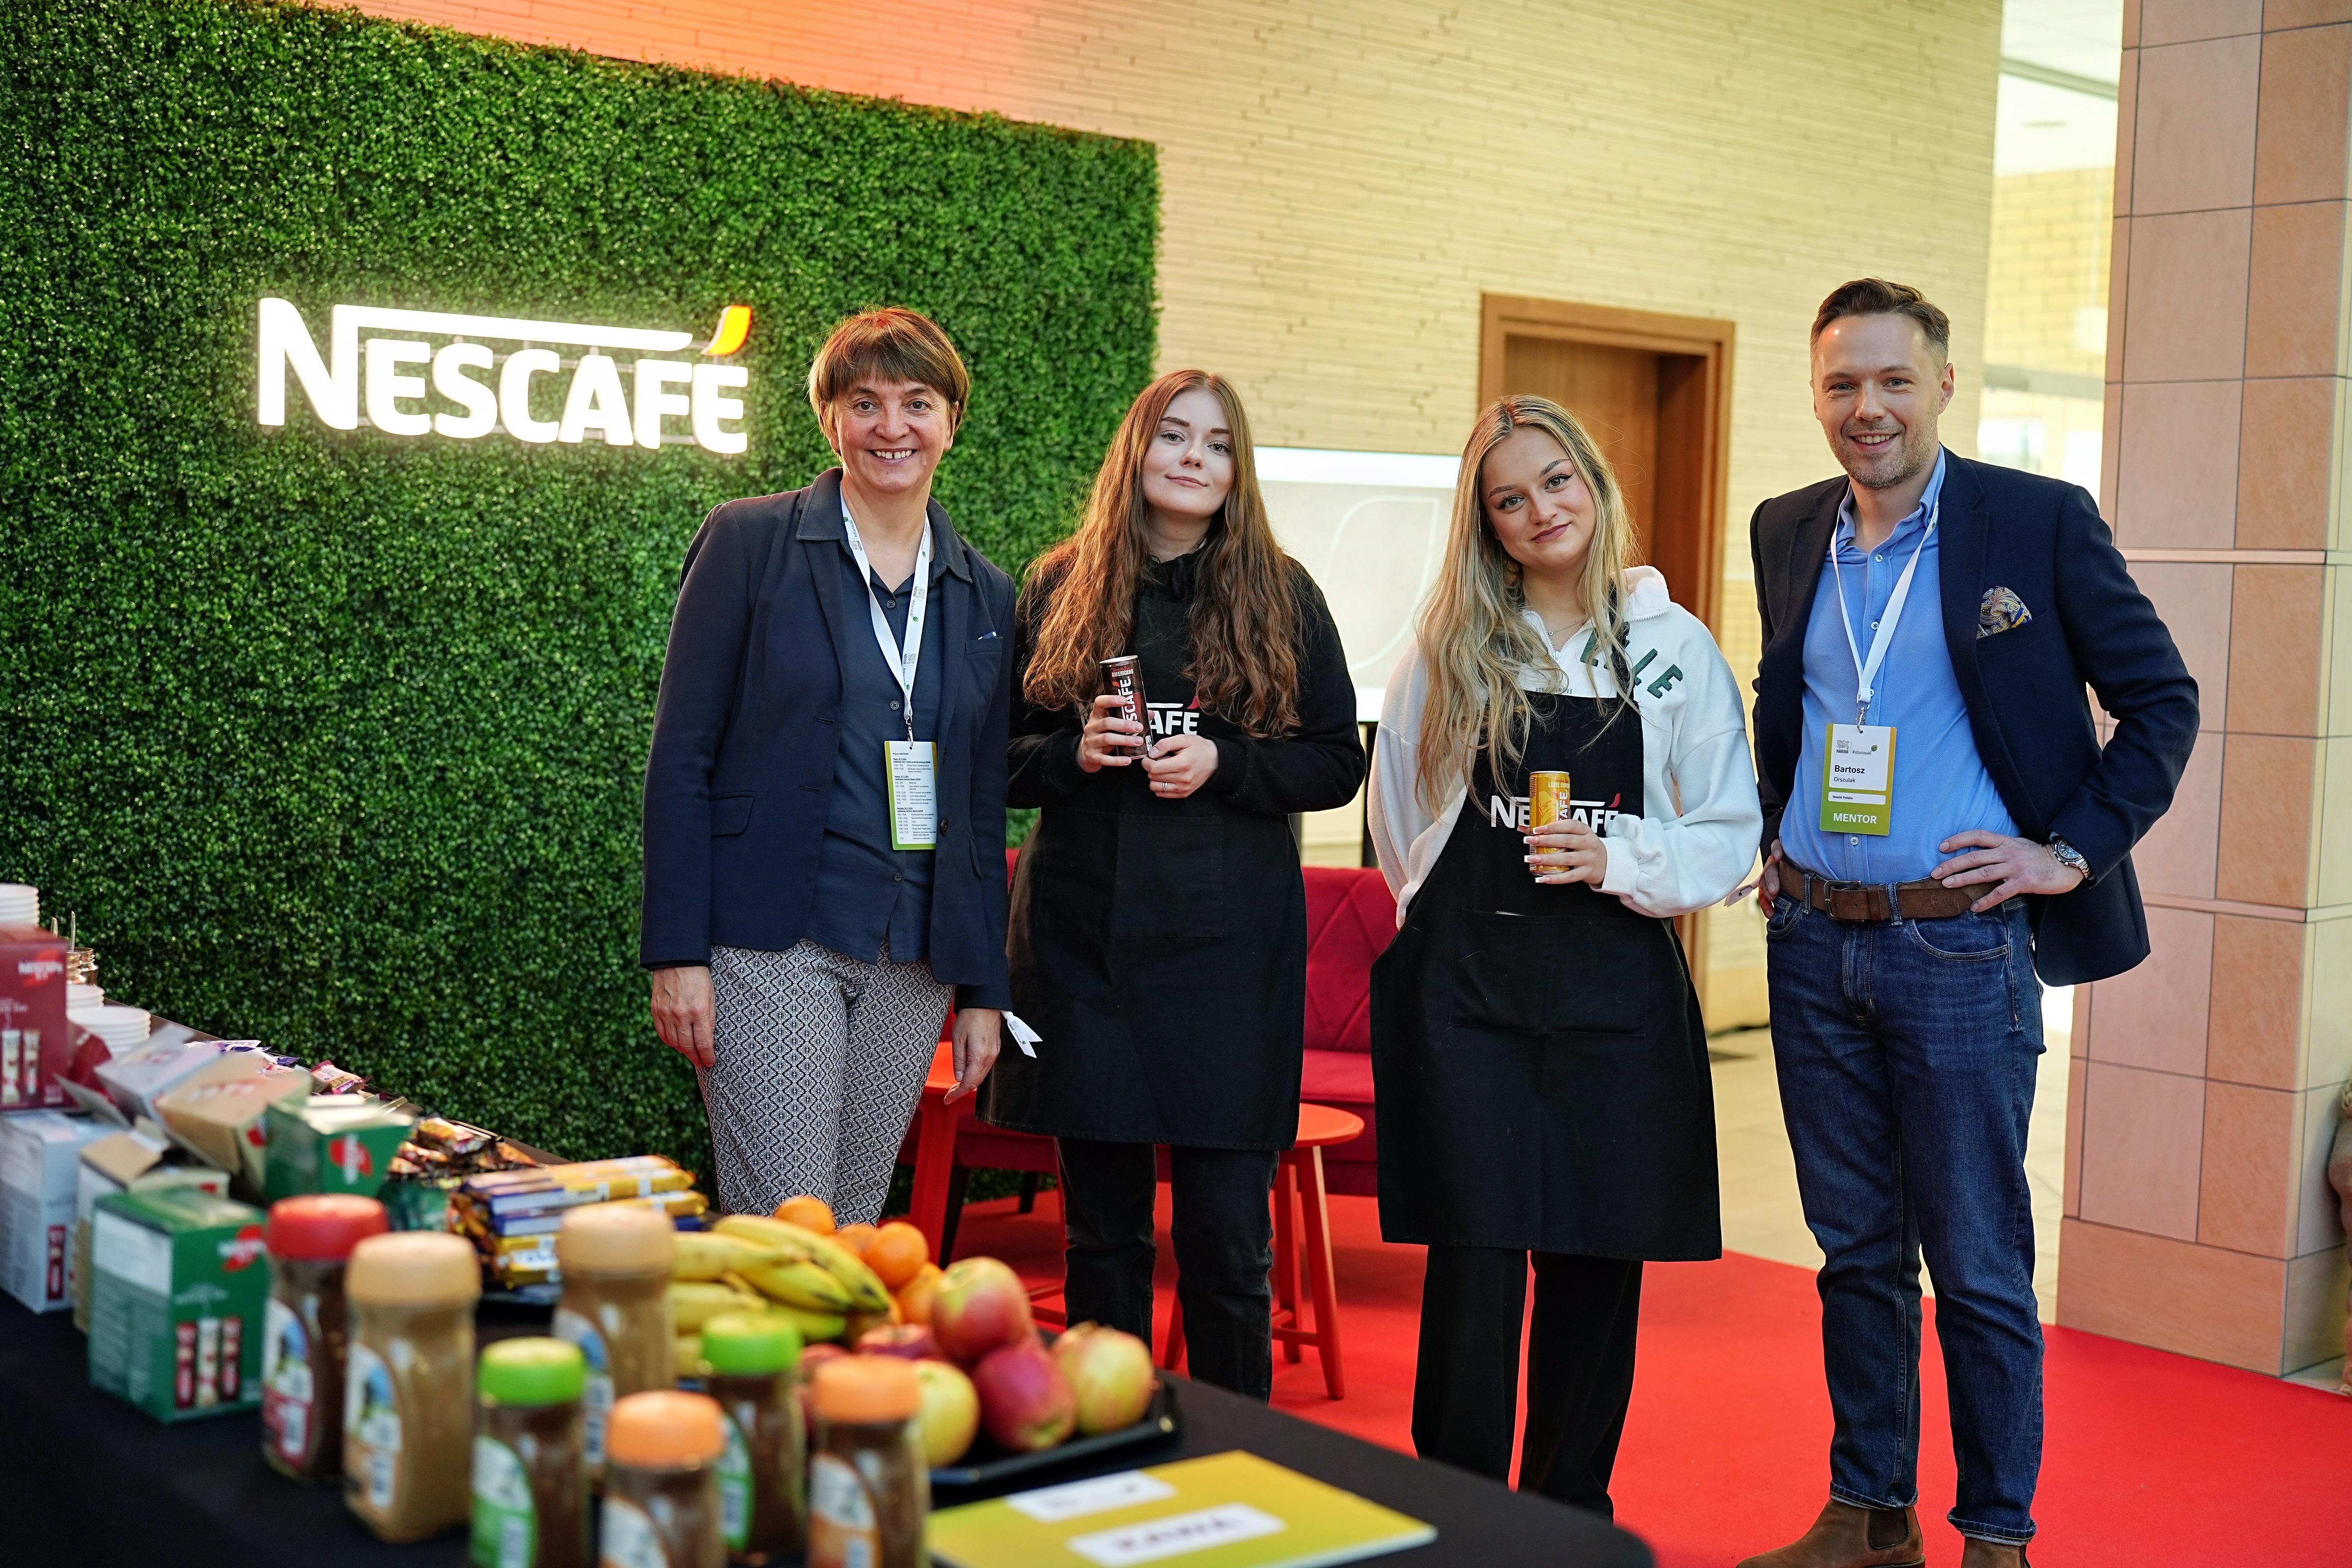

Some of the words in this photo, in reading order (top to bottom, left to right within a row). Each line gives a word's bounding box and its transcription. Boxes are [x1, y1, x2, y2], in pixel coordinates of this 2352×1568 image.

[257, 297, 752, 454] NESCAFÉ
[1112, 668, 1134, 677] AMERICANO
[1834, 765, 1865, 774] Bartosz
[1833, 813, 1877, 824] MENTOR
